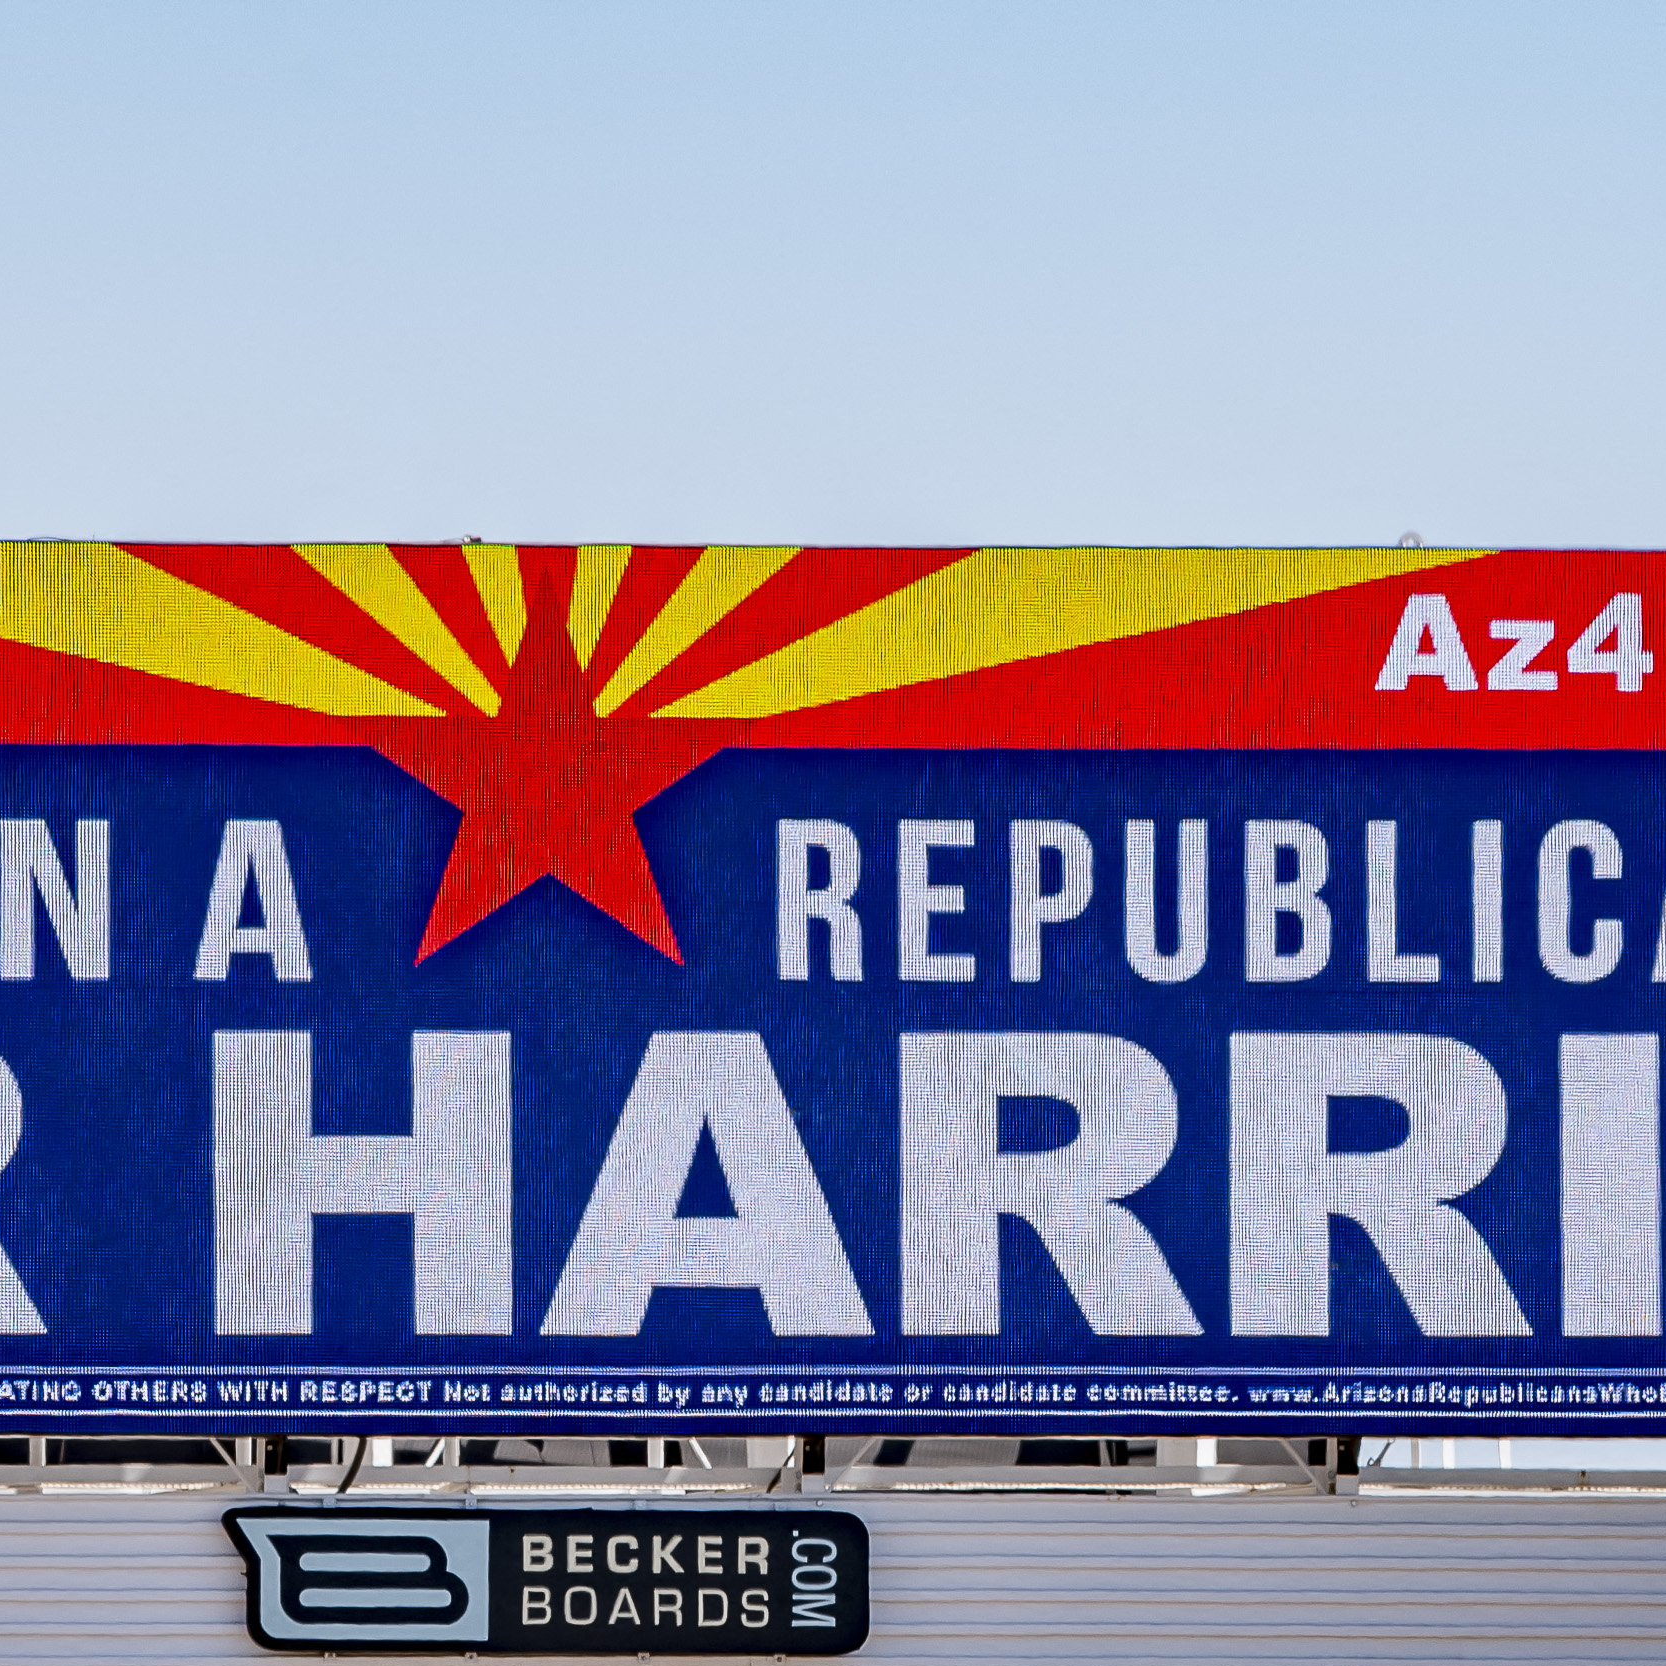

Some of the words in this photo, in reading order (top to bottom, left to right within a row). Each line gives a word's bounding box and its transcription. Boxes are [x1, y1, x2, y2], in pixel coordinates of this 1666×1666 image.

[91, 1380, 208, 1403] OTHERS
[218, 1380, 289, 1402] WITH
[300, 1380, 433, 1403] RESPECT
[443, 1381, 492, 1403] Not
[500, 1381, 649, 1403] authorized
[656, 1381, 690, 1409] by
[701, 1384, 749, 1410] any
[760, 1380, 895, 1403] candidate
[903, 1384, 932, 1403] or
[943, 1381, 1078, 1403] candidate
[521, 1534, 770, 1576] BECKER
[790, 1529, 838, 1628] .COM
[521, 1586, 770, 1628] BOARDS
